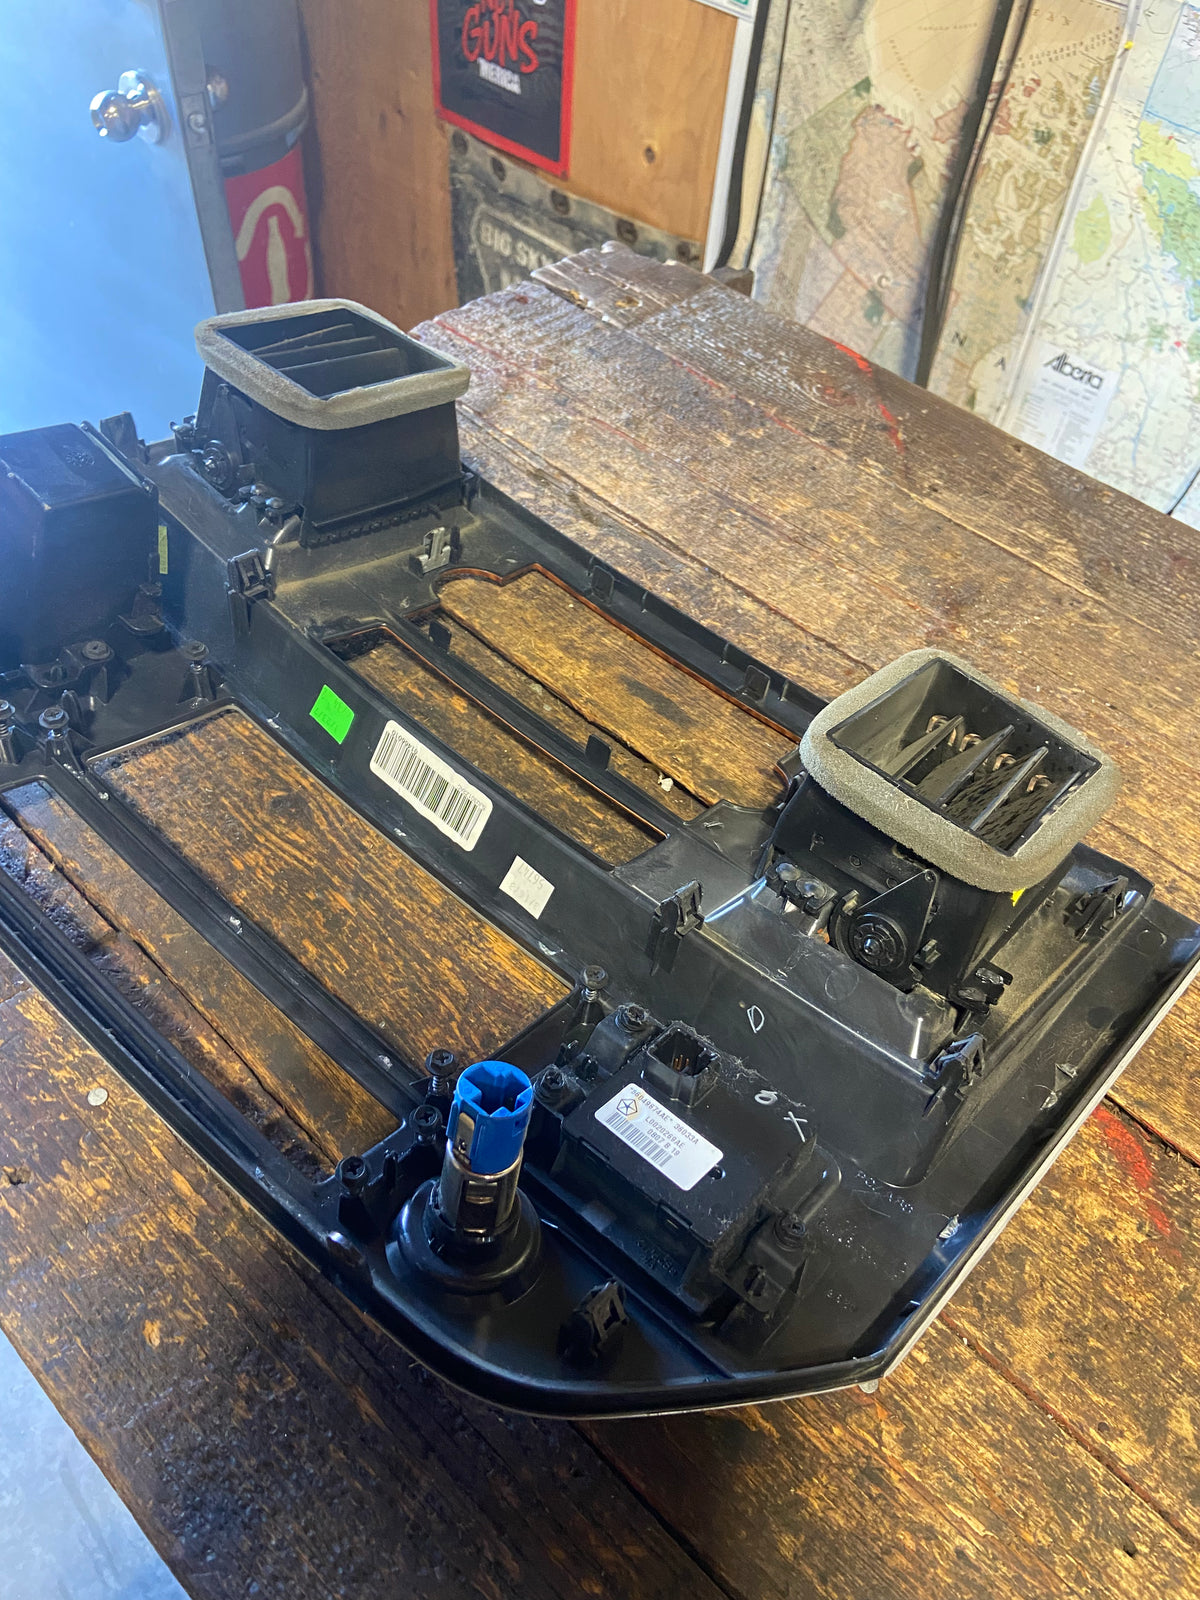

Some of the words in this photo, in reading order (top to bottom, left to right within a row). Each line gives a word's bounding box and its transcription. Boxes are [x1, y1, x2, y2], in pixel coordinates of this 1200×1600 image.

[461, 4, 540, 73] GUNS
[480, 221, 512, 258] BIG
[1043, 351, 1105, 390] Alberta
